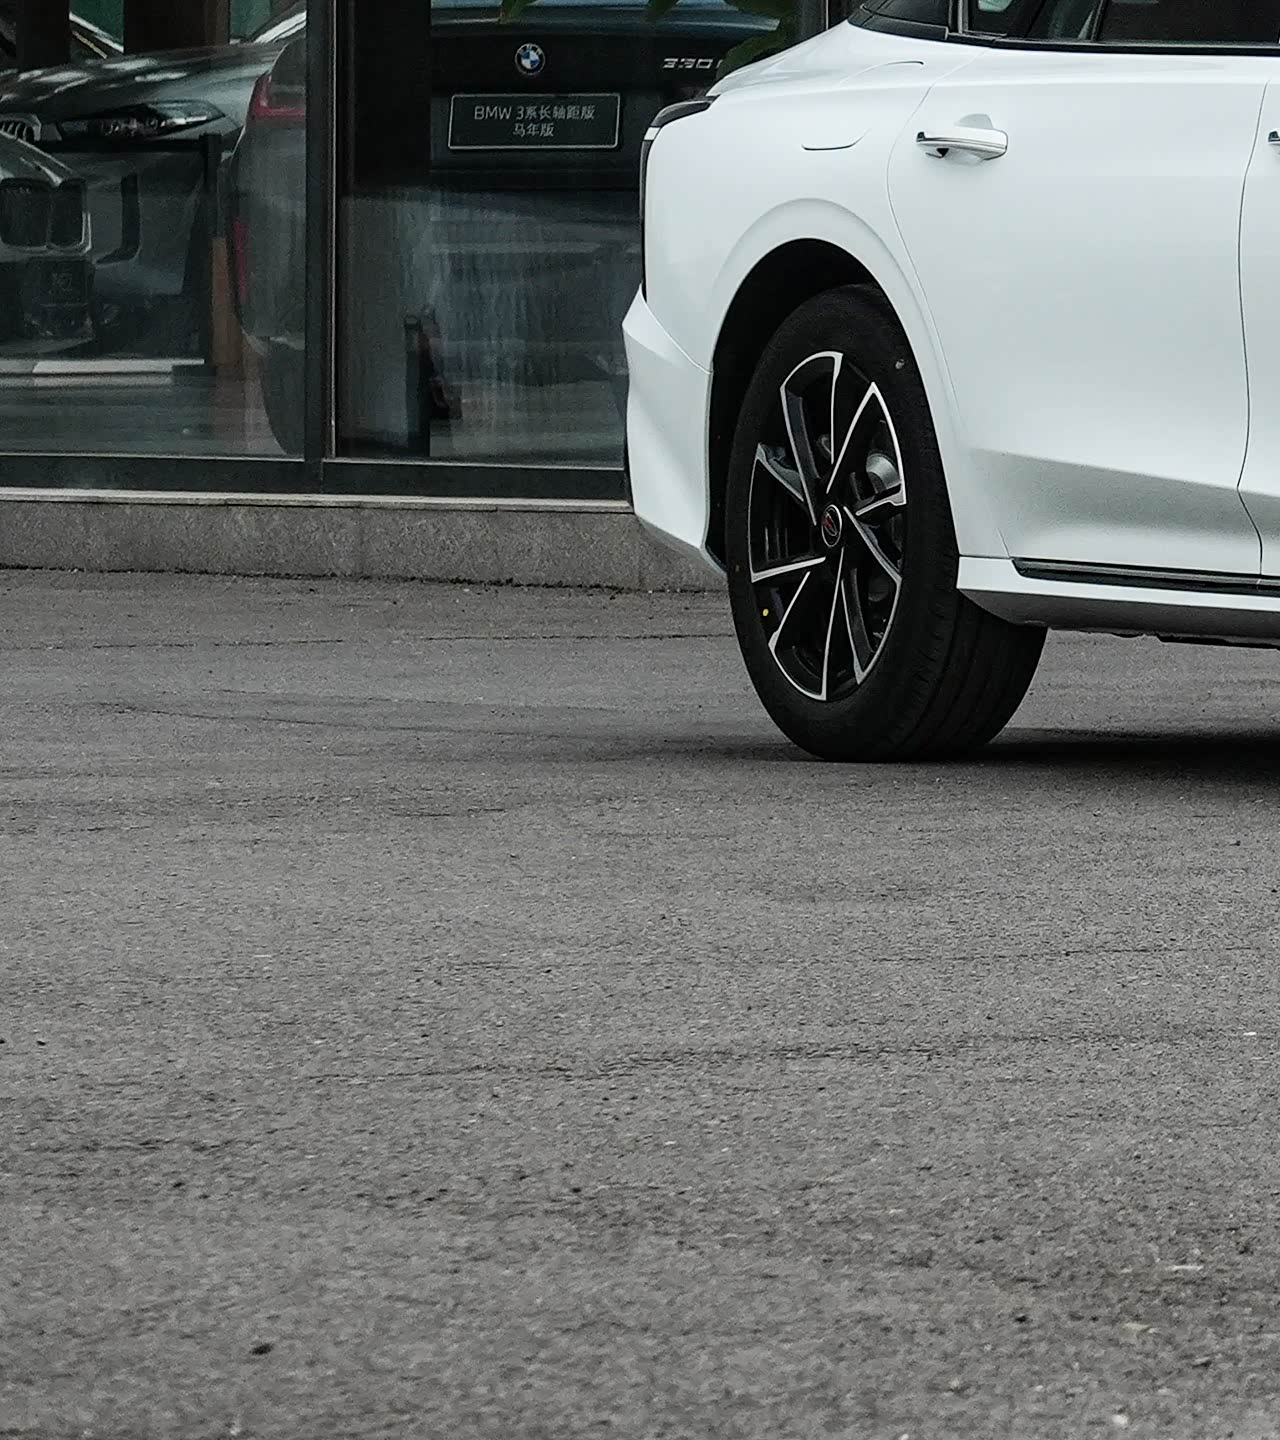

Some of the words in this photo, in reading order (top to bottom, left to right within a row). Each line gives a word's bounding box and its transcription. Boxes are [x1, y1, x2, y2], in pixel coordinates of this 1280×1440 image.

[474, 105, 511, 120] BMW
[512, 122, 554, 137] 马年版
